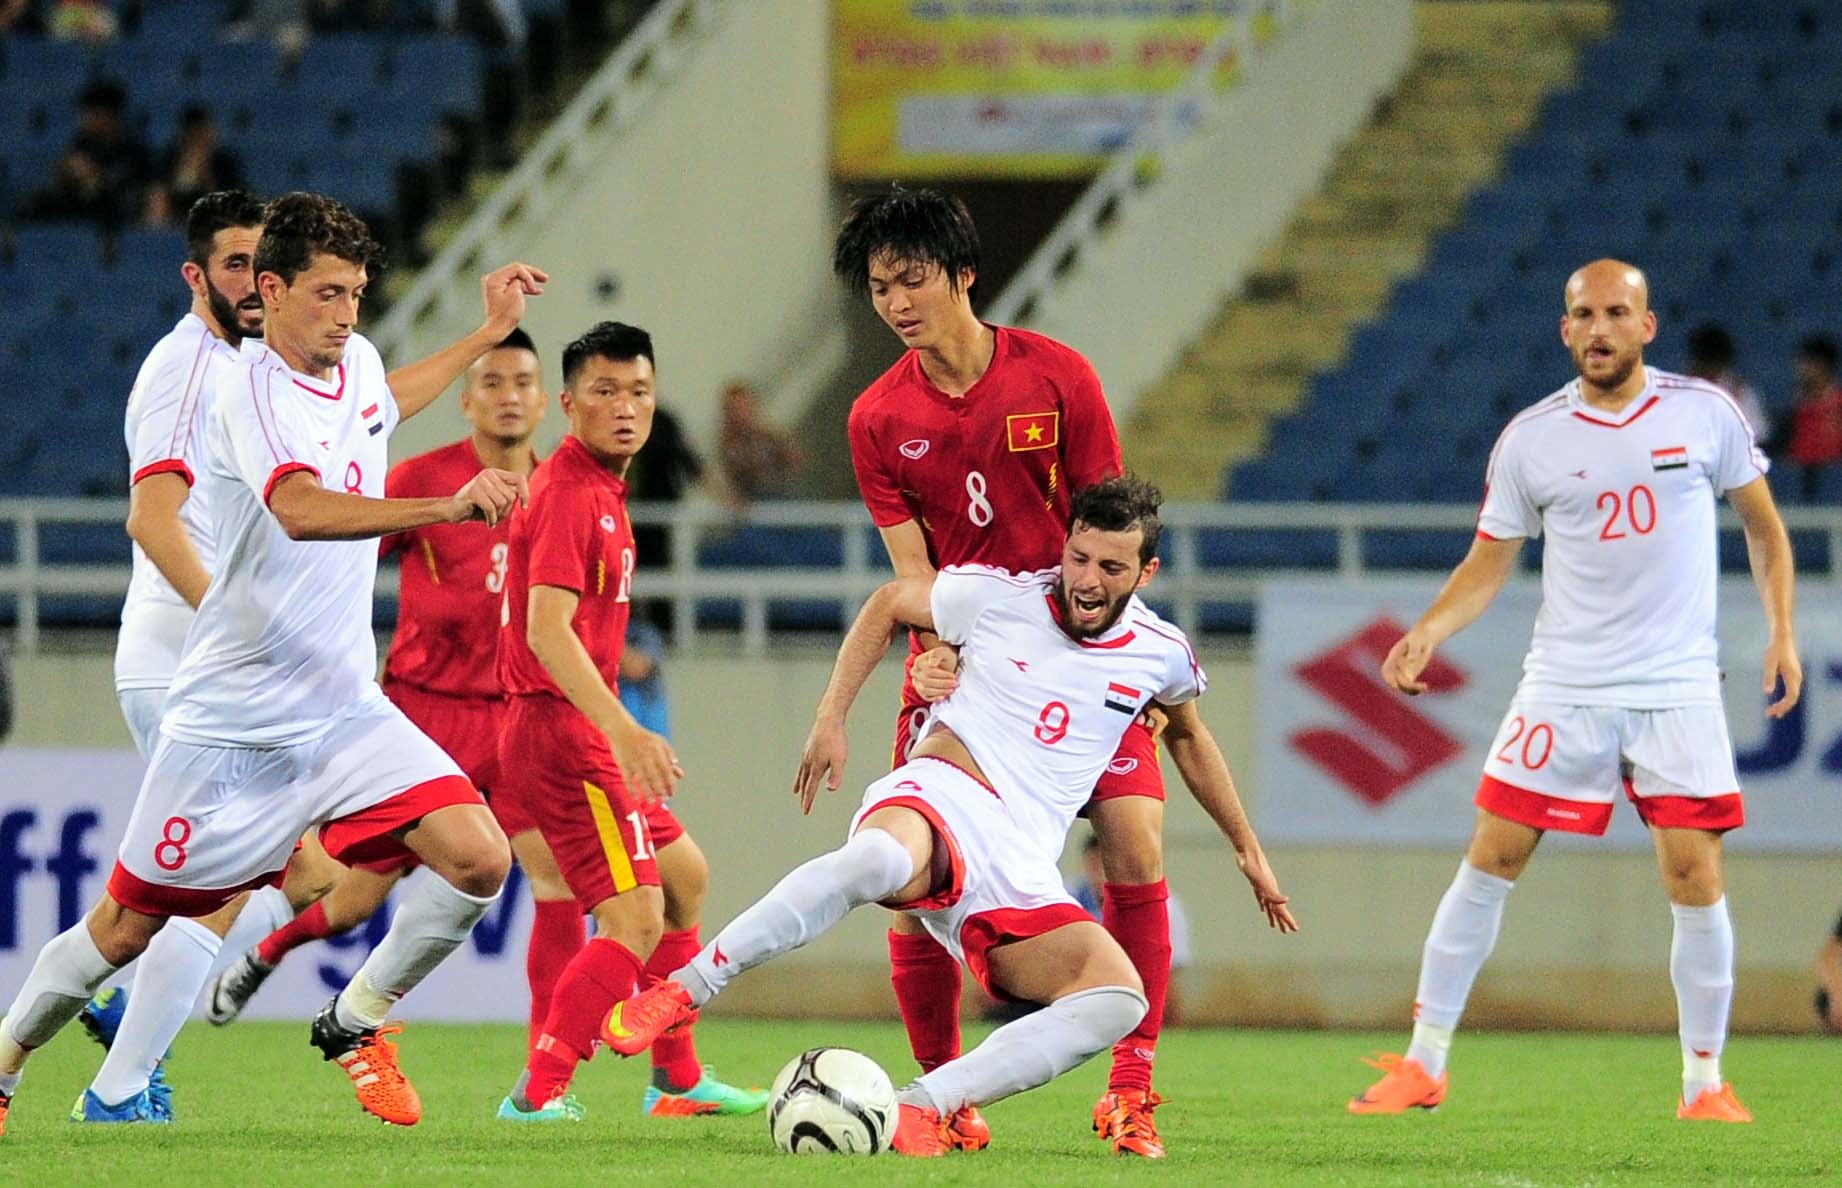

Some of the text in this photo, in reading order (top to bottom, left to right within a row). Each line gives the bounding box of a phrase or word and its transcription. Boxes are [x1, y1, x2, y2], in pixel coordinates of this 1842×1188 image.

[965, 470, 994, 528] 8
[1596, 483, 1658, 542] 20
[1033, 700, 1071, 745] 9
[1496, 714, 1555, 771] 20
[154, 815, 192, 871] 8
